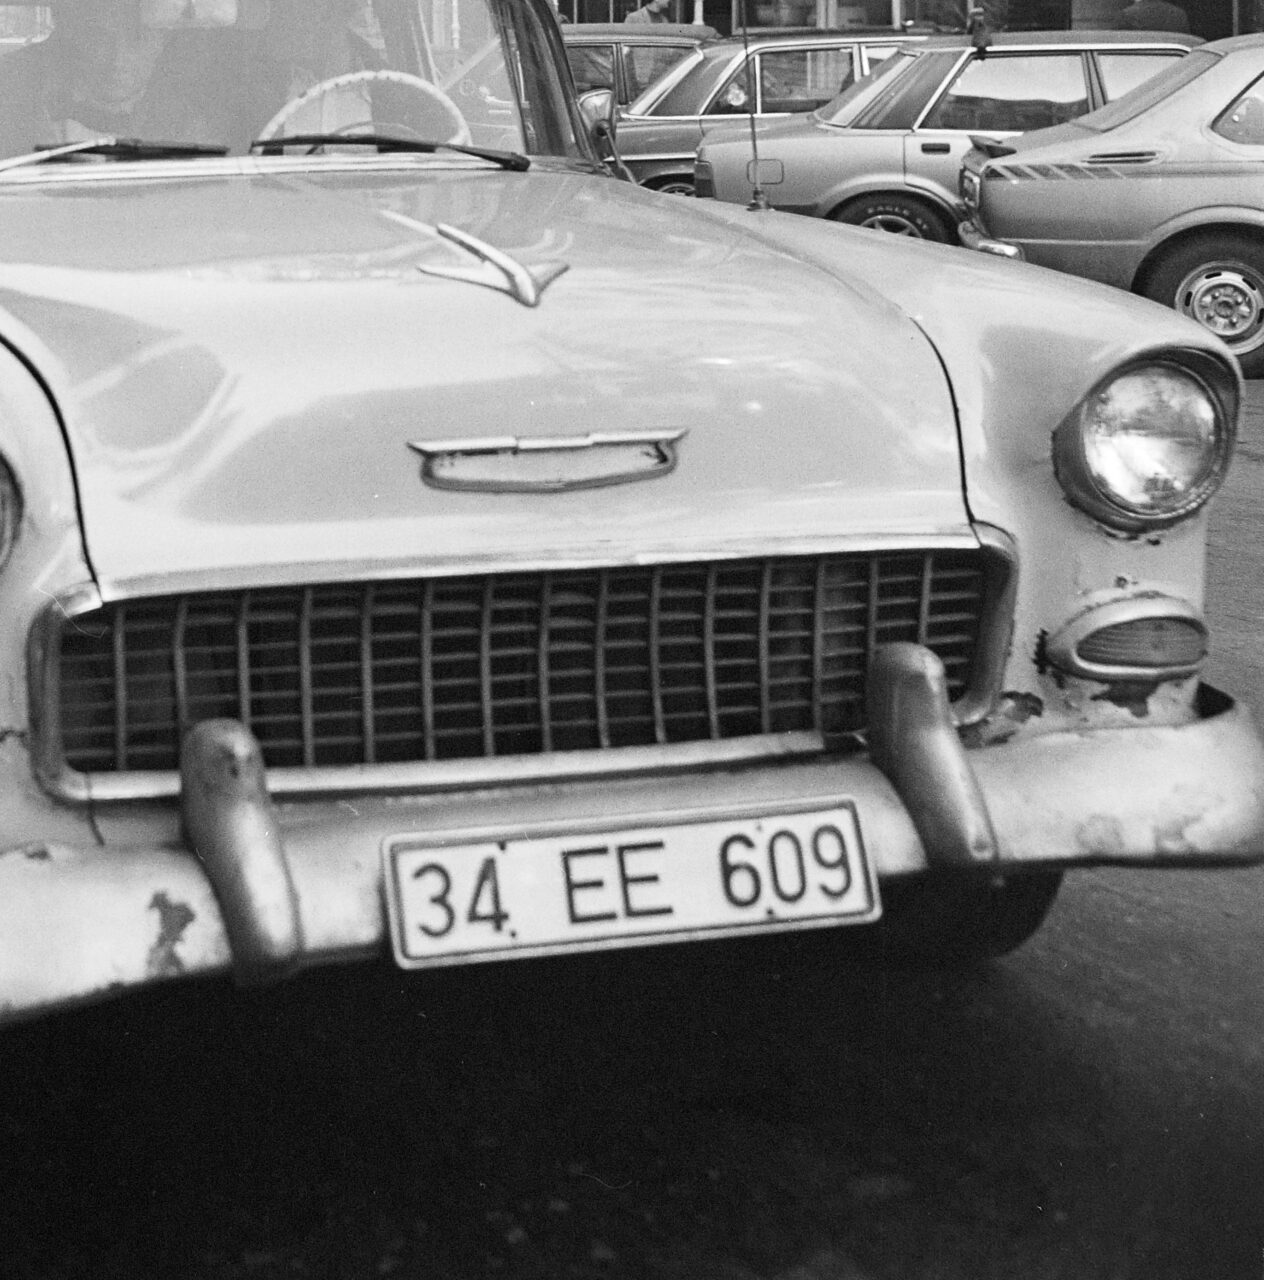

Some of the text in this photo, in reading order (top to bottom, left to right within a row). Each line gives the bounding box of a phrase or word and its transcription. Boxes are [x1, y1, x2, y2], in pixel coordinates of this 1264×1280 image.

[411, 823, 853, 939] 34 EE 609
